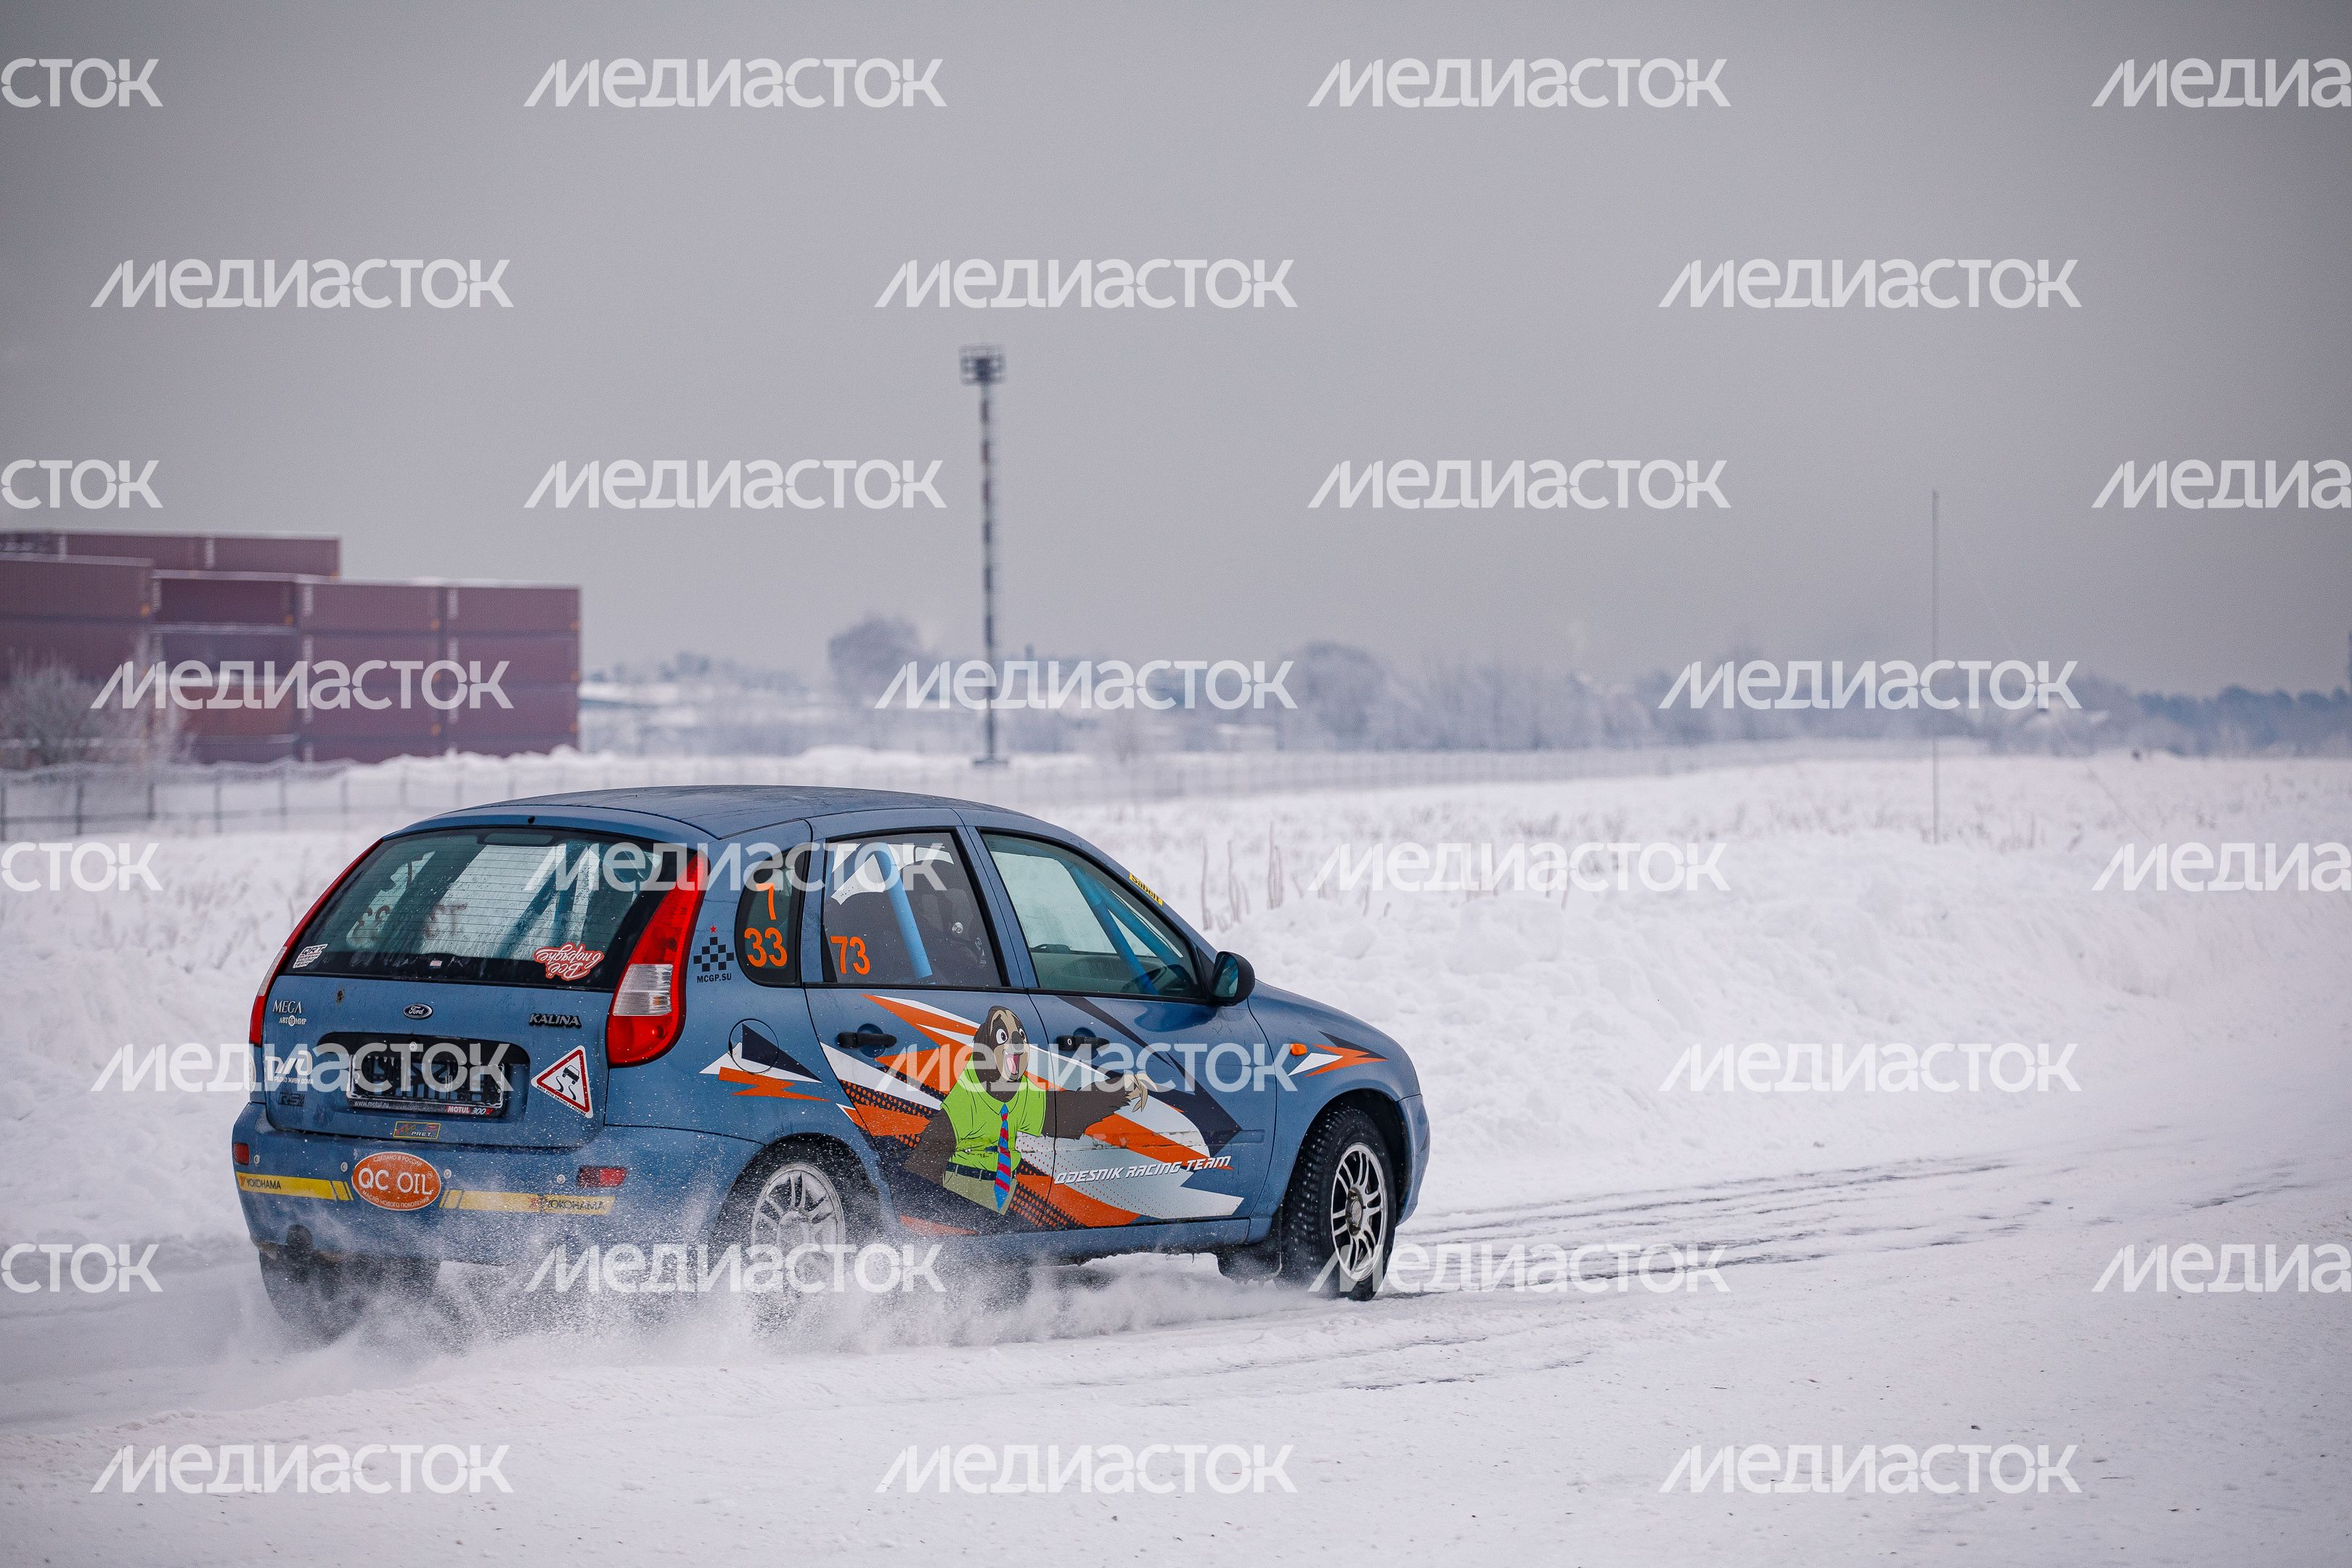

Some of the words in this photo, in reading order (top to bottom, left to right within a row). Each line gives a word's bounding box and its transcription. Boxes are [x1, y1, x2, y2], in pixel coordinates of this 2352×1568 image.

[756, 882, 777, 920] 7
[744, 927, 788, 968] 33
[830, 936, 870, 975] 73
[697, 973, 732, 983] MCGP.SU
[272, 1000, 302, 1013] MEGA
[529, 1013, 581, 1026] KALINA
[1125, 1161, 1182, 1178] RACING
[1186, 1156, 1231, 1172] TEAM
[246, 1178, 282, 1190] YOKOHAMA
[358, 1167, 389, 1191] QC
[397, 1172, 433, 1195] OIL
